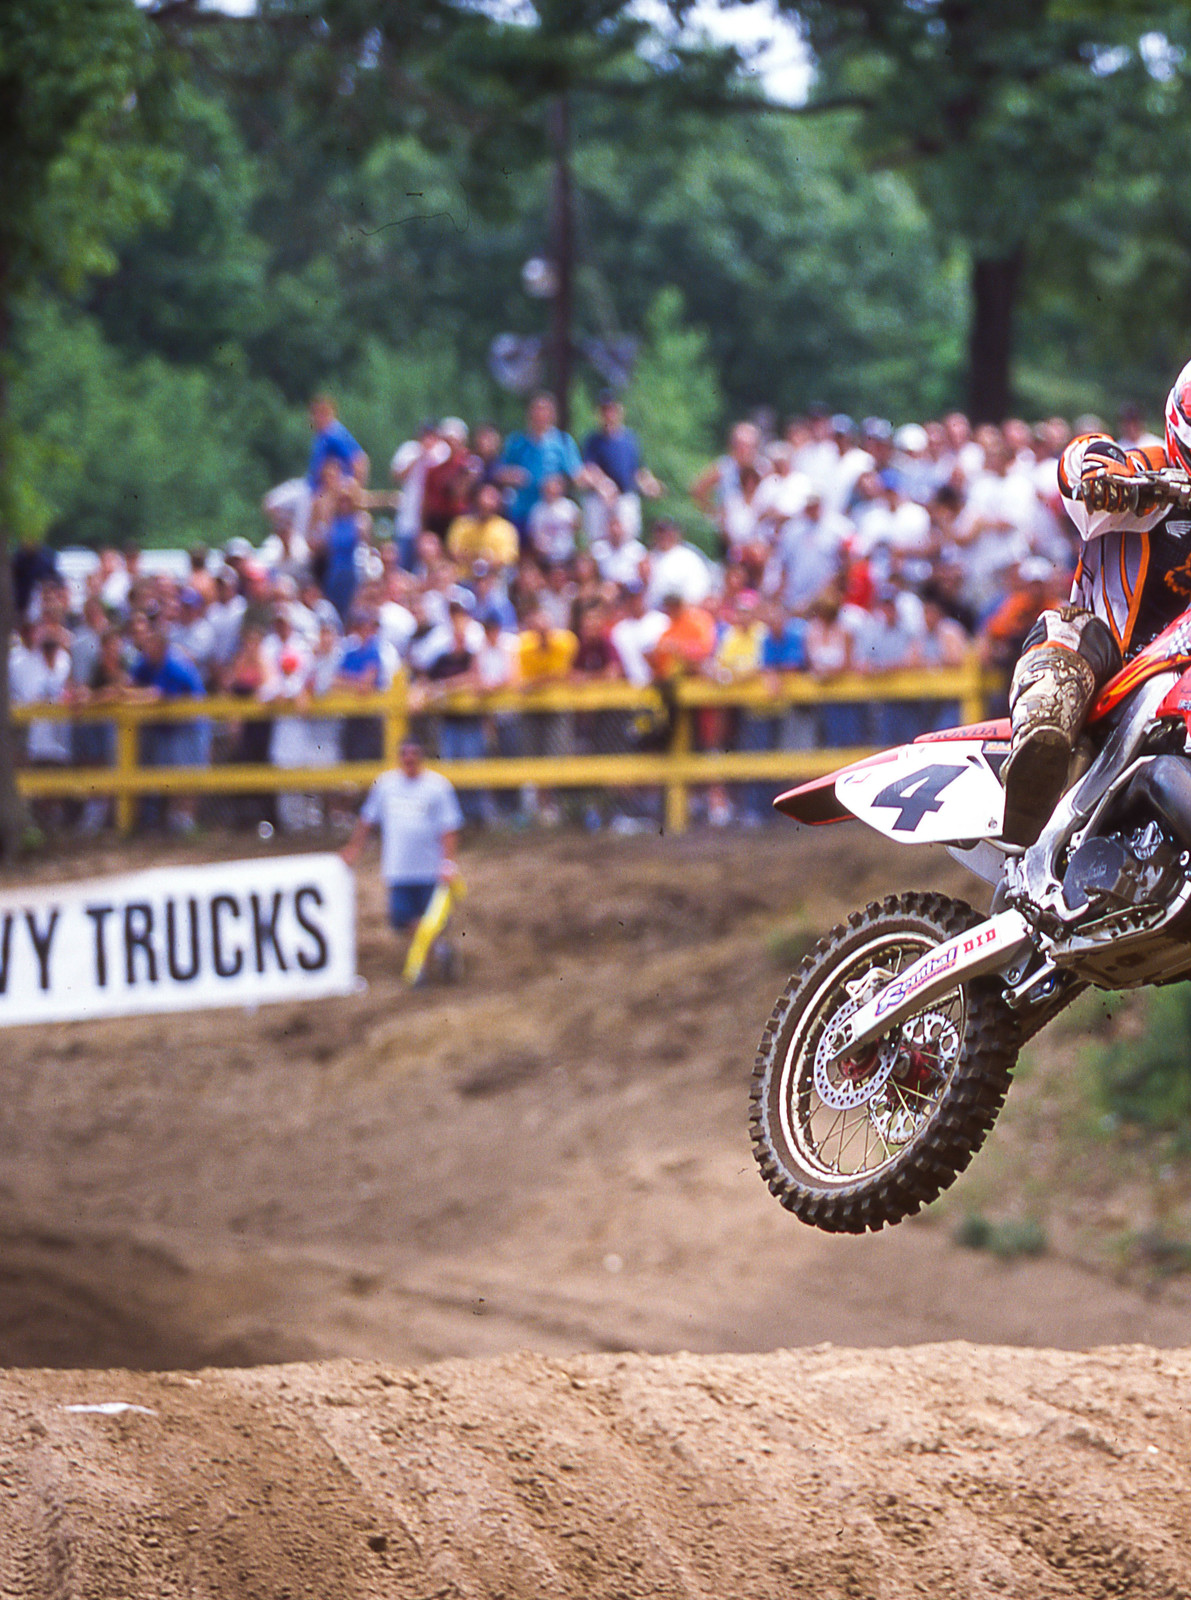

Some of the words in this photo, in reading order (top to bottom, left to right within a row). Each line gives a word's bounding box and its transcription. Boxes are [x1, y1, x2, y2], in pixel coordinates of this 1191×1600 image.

[871, 763, 969, 832] 4
[86, 885, 328, 987] TRUCKS
[875, 944, 959, 1017] Renthal
[963, 928, 996, 954] DID
